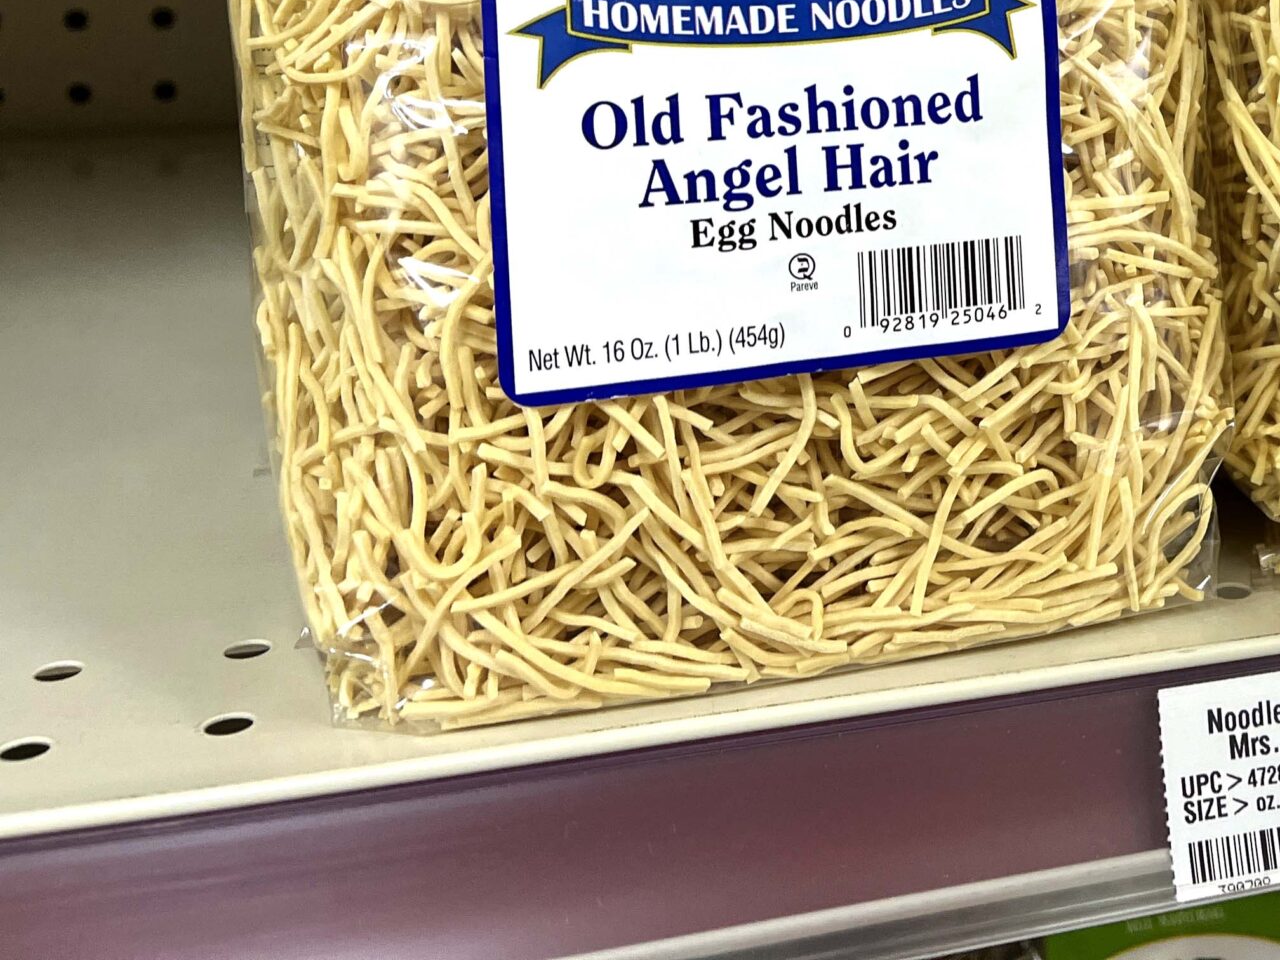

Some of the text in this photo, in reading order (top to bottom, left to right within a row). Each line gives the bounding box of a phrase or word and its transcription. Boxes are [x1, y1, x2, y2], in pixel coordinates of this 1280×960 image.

[580, 73, 984, 151] Old Fashioned
[638, 139, 939, 212] Angel Hair
[690, 203, 898, 253] Egg Noodles
[790, 280, 819, 292] Pareve
[843, 303, 1042, 339] 0 92819 25046 2
[528, 323, 786, 373] Net Wt. 16 Oz. (1 Lb.) (454g)
[1229, 733, 1279, 760] Mrs.
[1180, 770, 1223, 798] UPC
[1184, 795, 1228, 824] SIZE
[1256, 795, 1280, 812] oz.
